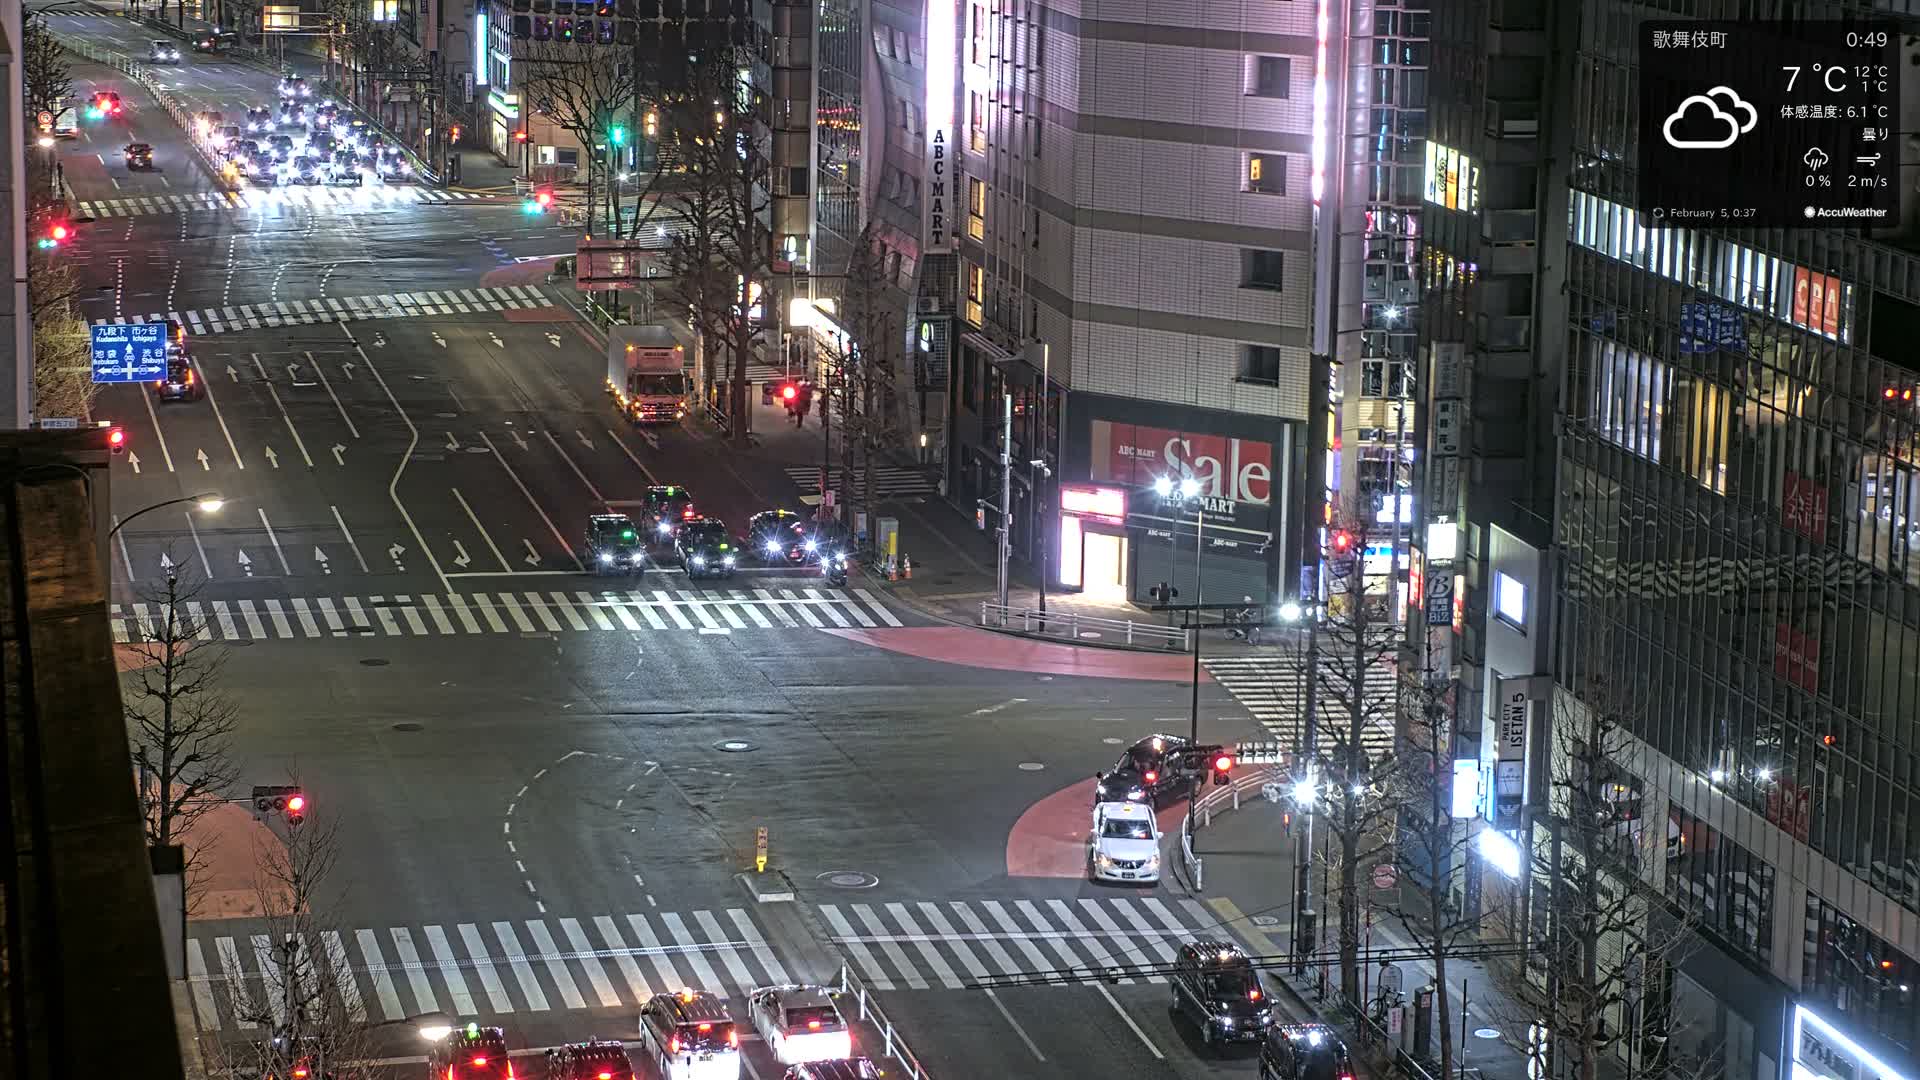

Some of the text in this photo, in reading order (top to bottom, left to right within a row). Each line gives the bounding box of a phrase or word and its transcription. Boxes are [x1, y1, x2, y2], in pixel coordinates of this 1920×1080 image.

[1797, 278, 1838, 322] CPA
[98, 326, 126, 336] 九段下
[94, 348, 163, 358] 池袋 渋谷
[1163, 437, 1271, 505] Sale
[1504, 703, 1512, 741] PARK CITY
[1511, 692, 1525, 747] ISETAN 5
